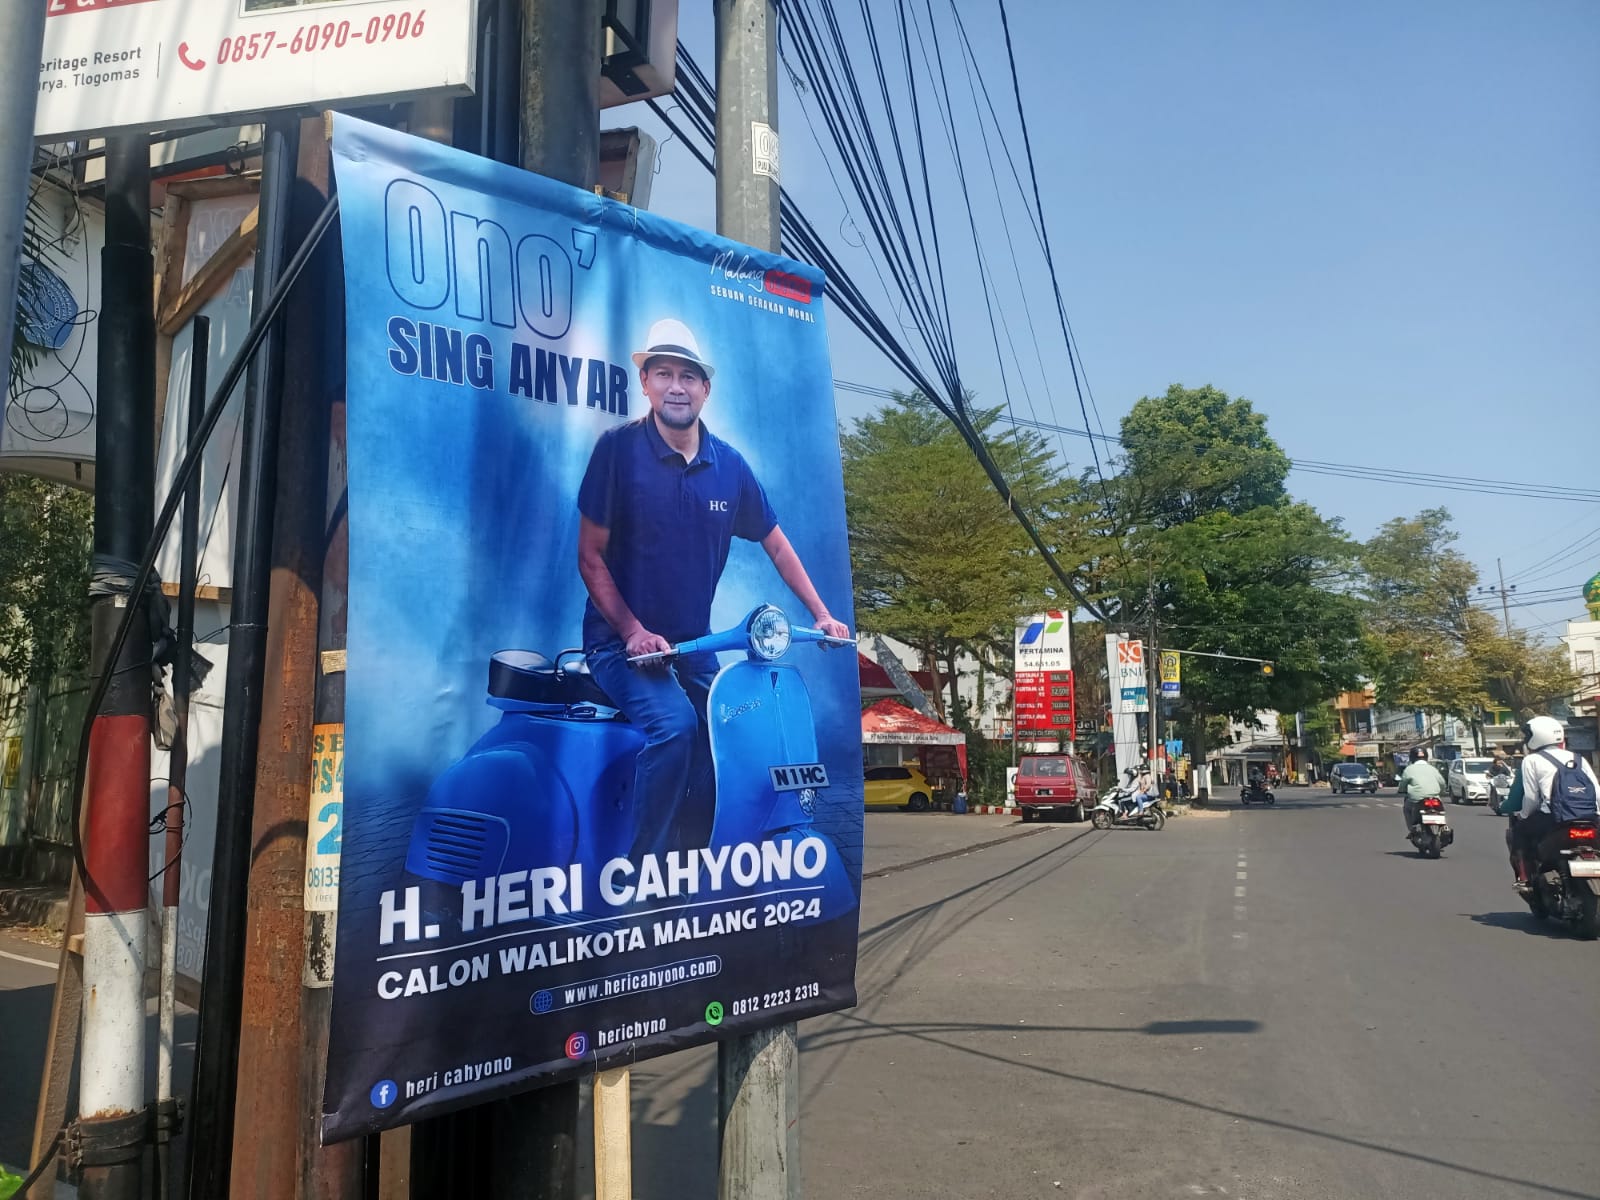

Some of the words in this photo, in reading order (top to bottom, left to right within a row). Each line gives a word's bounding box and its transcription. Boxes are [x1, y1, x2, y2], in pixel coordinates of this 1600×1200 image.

[93, 47, 142, 65] Resort
[217, 9, 426, 65] 0857-6090-0906
[73, 68, 140, 87] Tlogomas
[710, 250, 765, 292] Malang
[710, 284, 745, 303] SEBUAH
[787, 306, 816, 323] MORAL
[387, 316, 495, 391] SING
[508, 342, 630, 417] ANYAR
[710, 500, 728, 511] HC
[1019, 647, 1064, 655] PERTAMINA
[1120, 667, 1142, 677] BNI
[379, 886, 440, 945] H.
[461, 863, 583, 932] HERI
[599, 836, 827, 906] CAHYONO
[377, 953, 490, 1000] CALON
[499, 926, 646, 975] WALIKOTA
[653, 908, 757, 947] MALANG
[764, 898, 821, 927] 2024
[565, 959, 717, 1004] www.hericahyono.com
[732, 996, 760, 1016] 0812
[763, 989, 792, 1009] 2223
[795, 982, 820, 1001] 2319
[597, 1016, 667, 1048] herichyno
[405, 1071, 438, 1098] heri
[444, 1056, 513, 1086] cahyono
